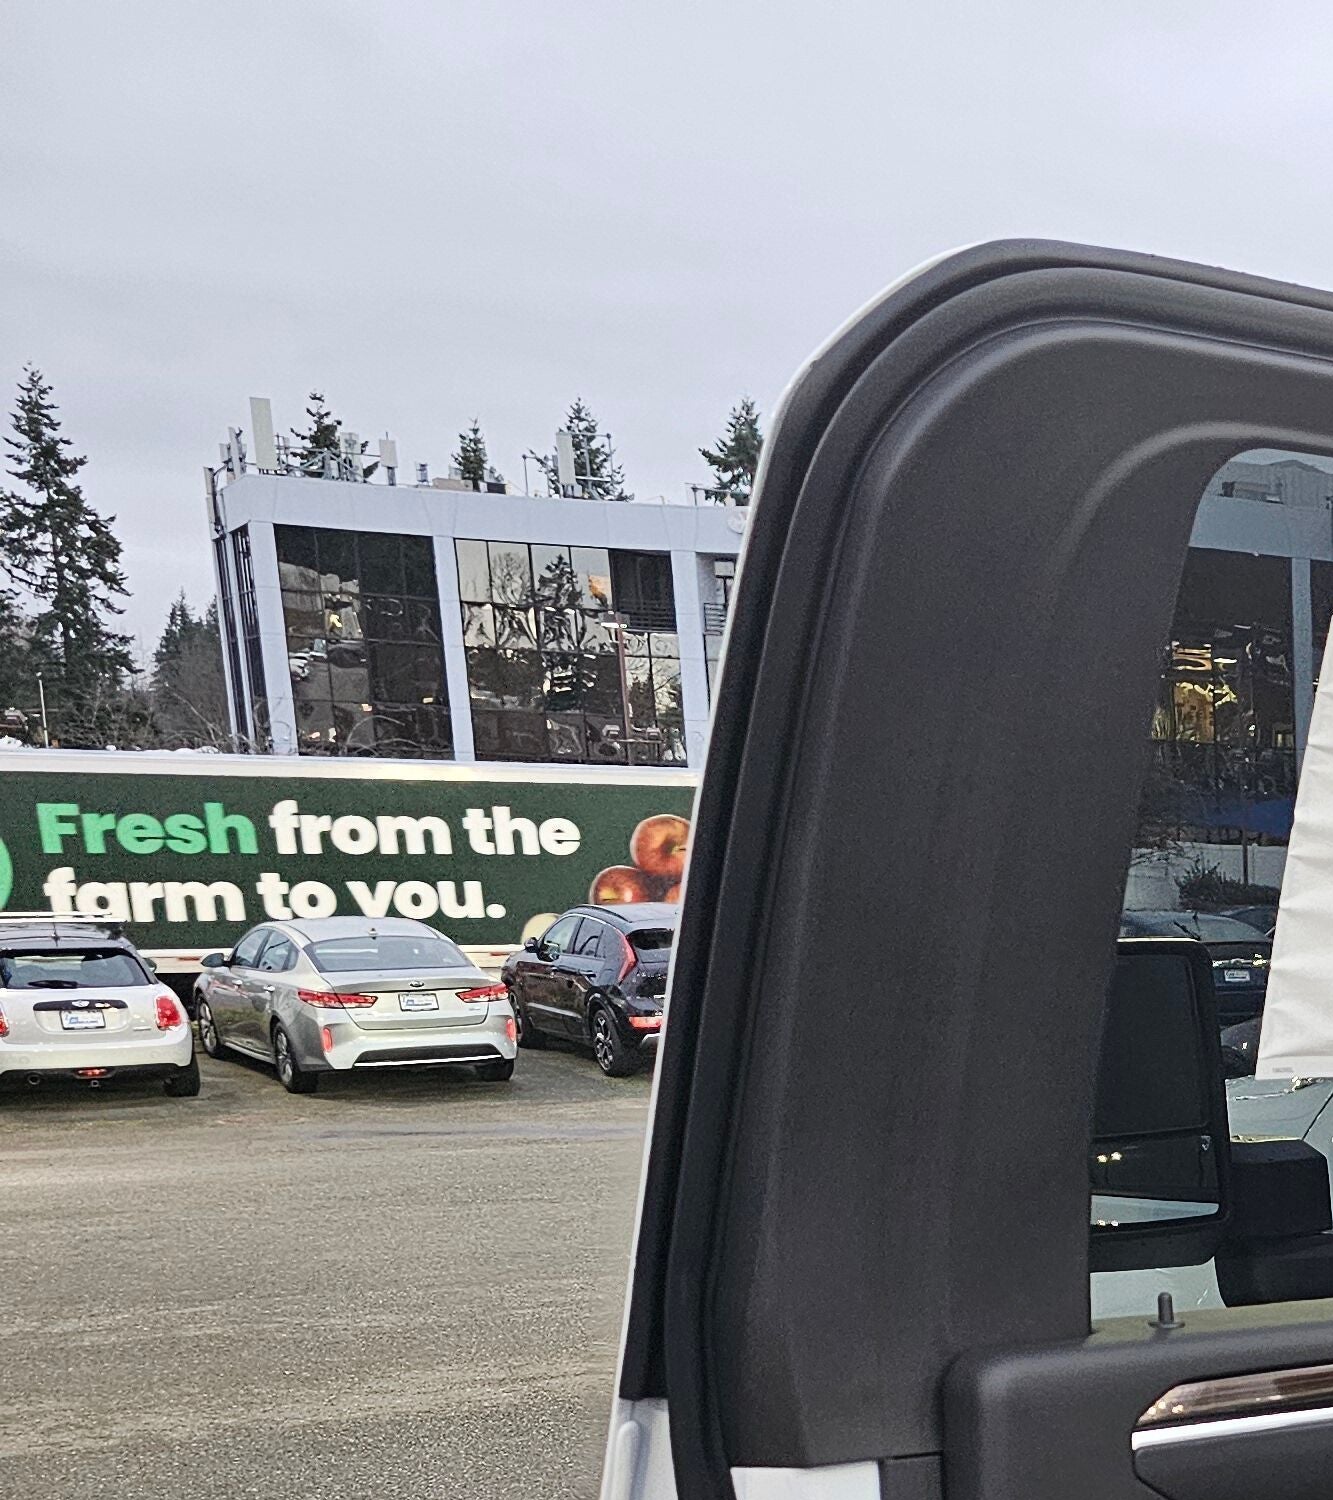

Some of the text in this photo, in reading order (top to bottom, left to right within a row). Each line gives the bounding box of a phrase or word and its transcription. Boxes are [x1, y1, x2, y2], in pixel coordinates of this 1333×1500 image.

[36, 799, 581, 856] Fresh from the
[44, 867, 507, 923] farm to you.
